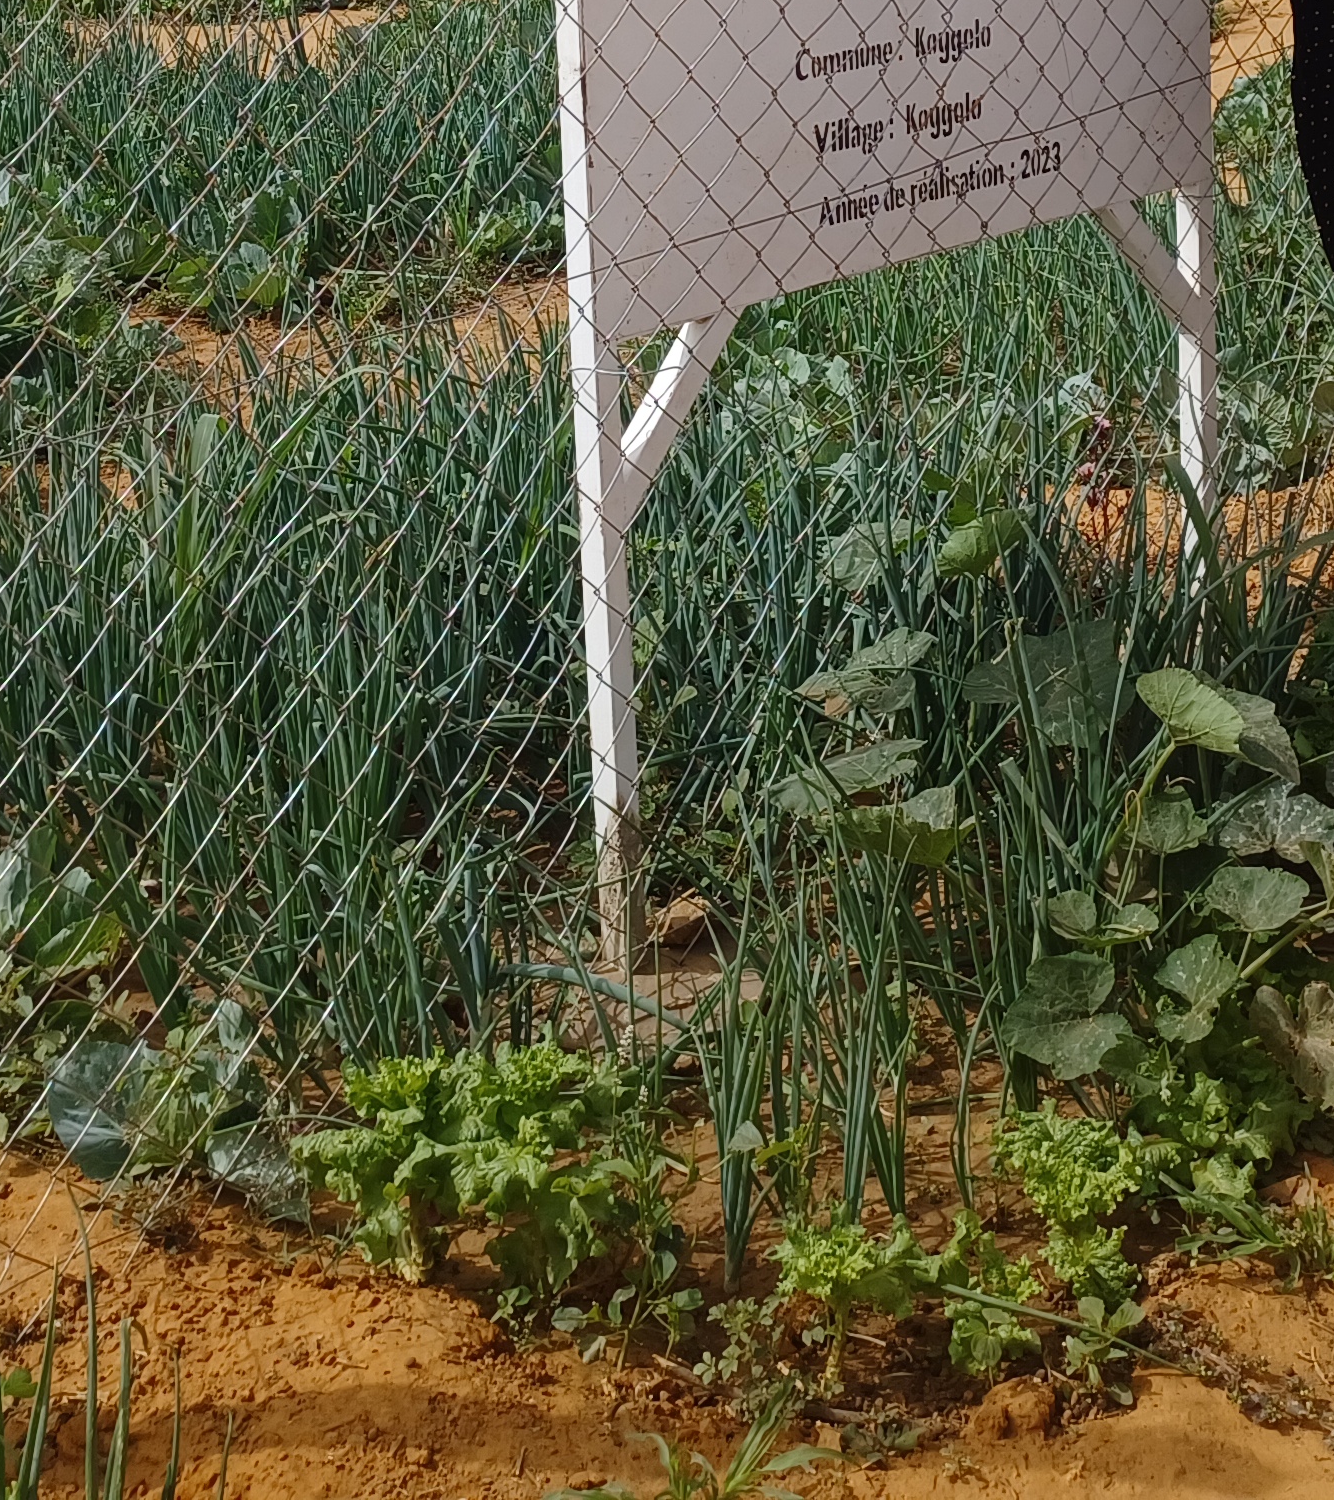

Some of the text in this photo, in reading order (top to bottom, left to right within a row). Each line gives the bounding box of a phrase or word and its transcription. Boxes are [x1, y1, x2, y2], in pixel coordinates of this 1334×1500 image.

[813, 117, 884, 155] Village
[819, 184, 880, 226] Année
[883, 181, 906, 211] de
[910, 159, 1005, 203] réalisation
[1020, 141, 1062, 180] 2023
